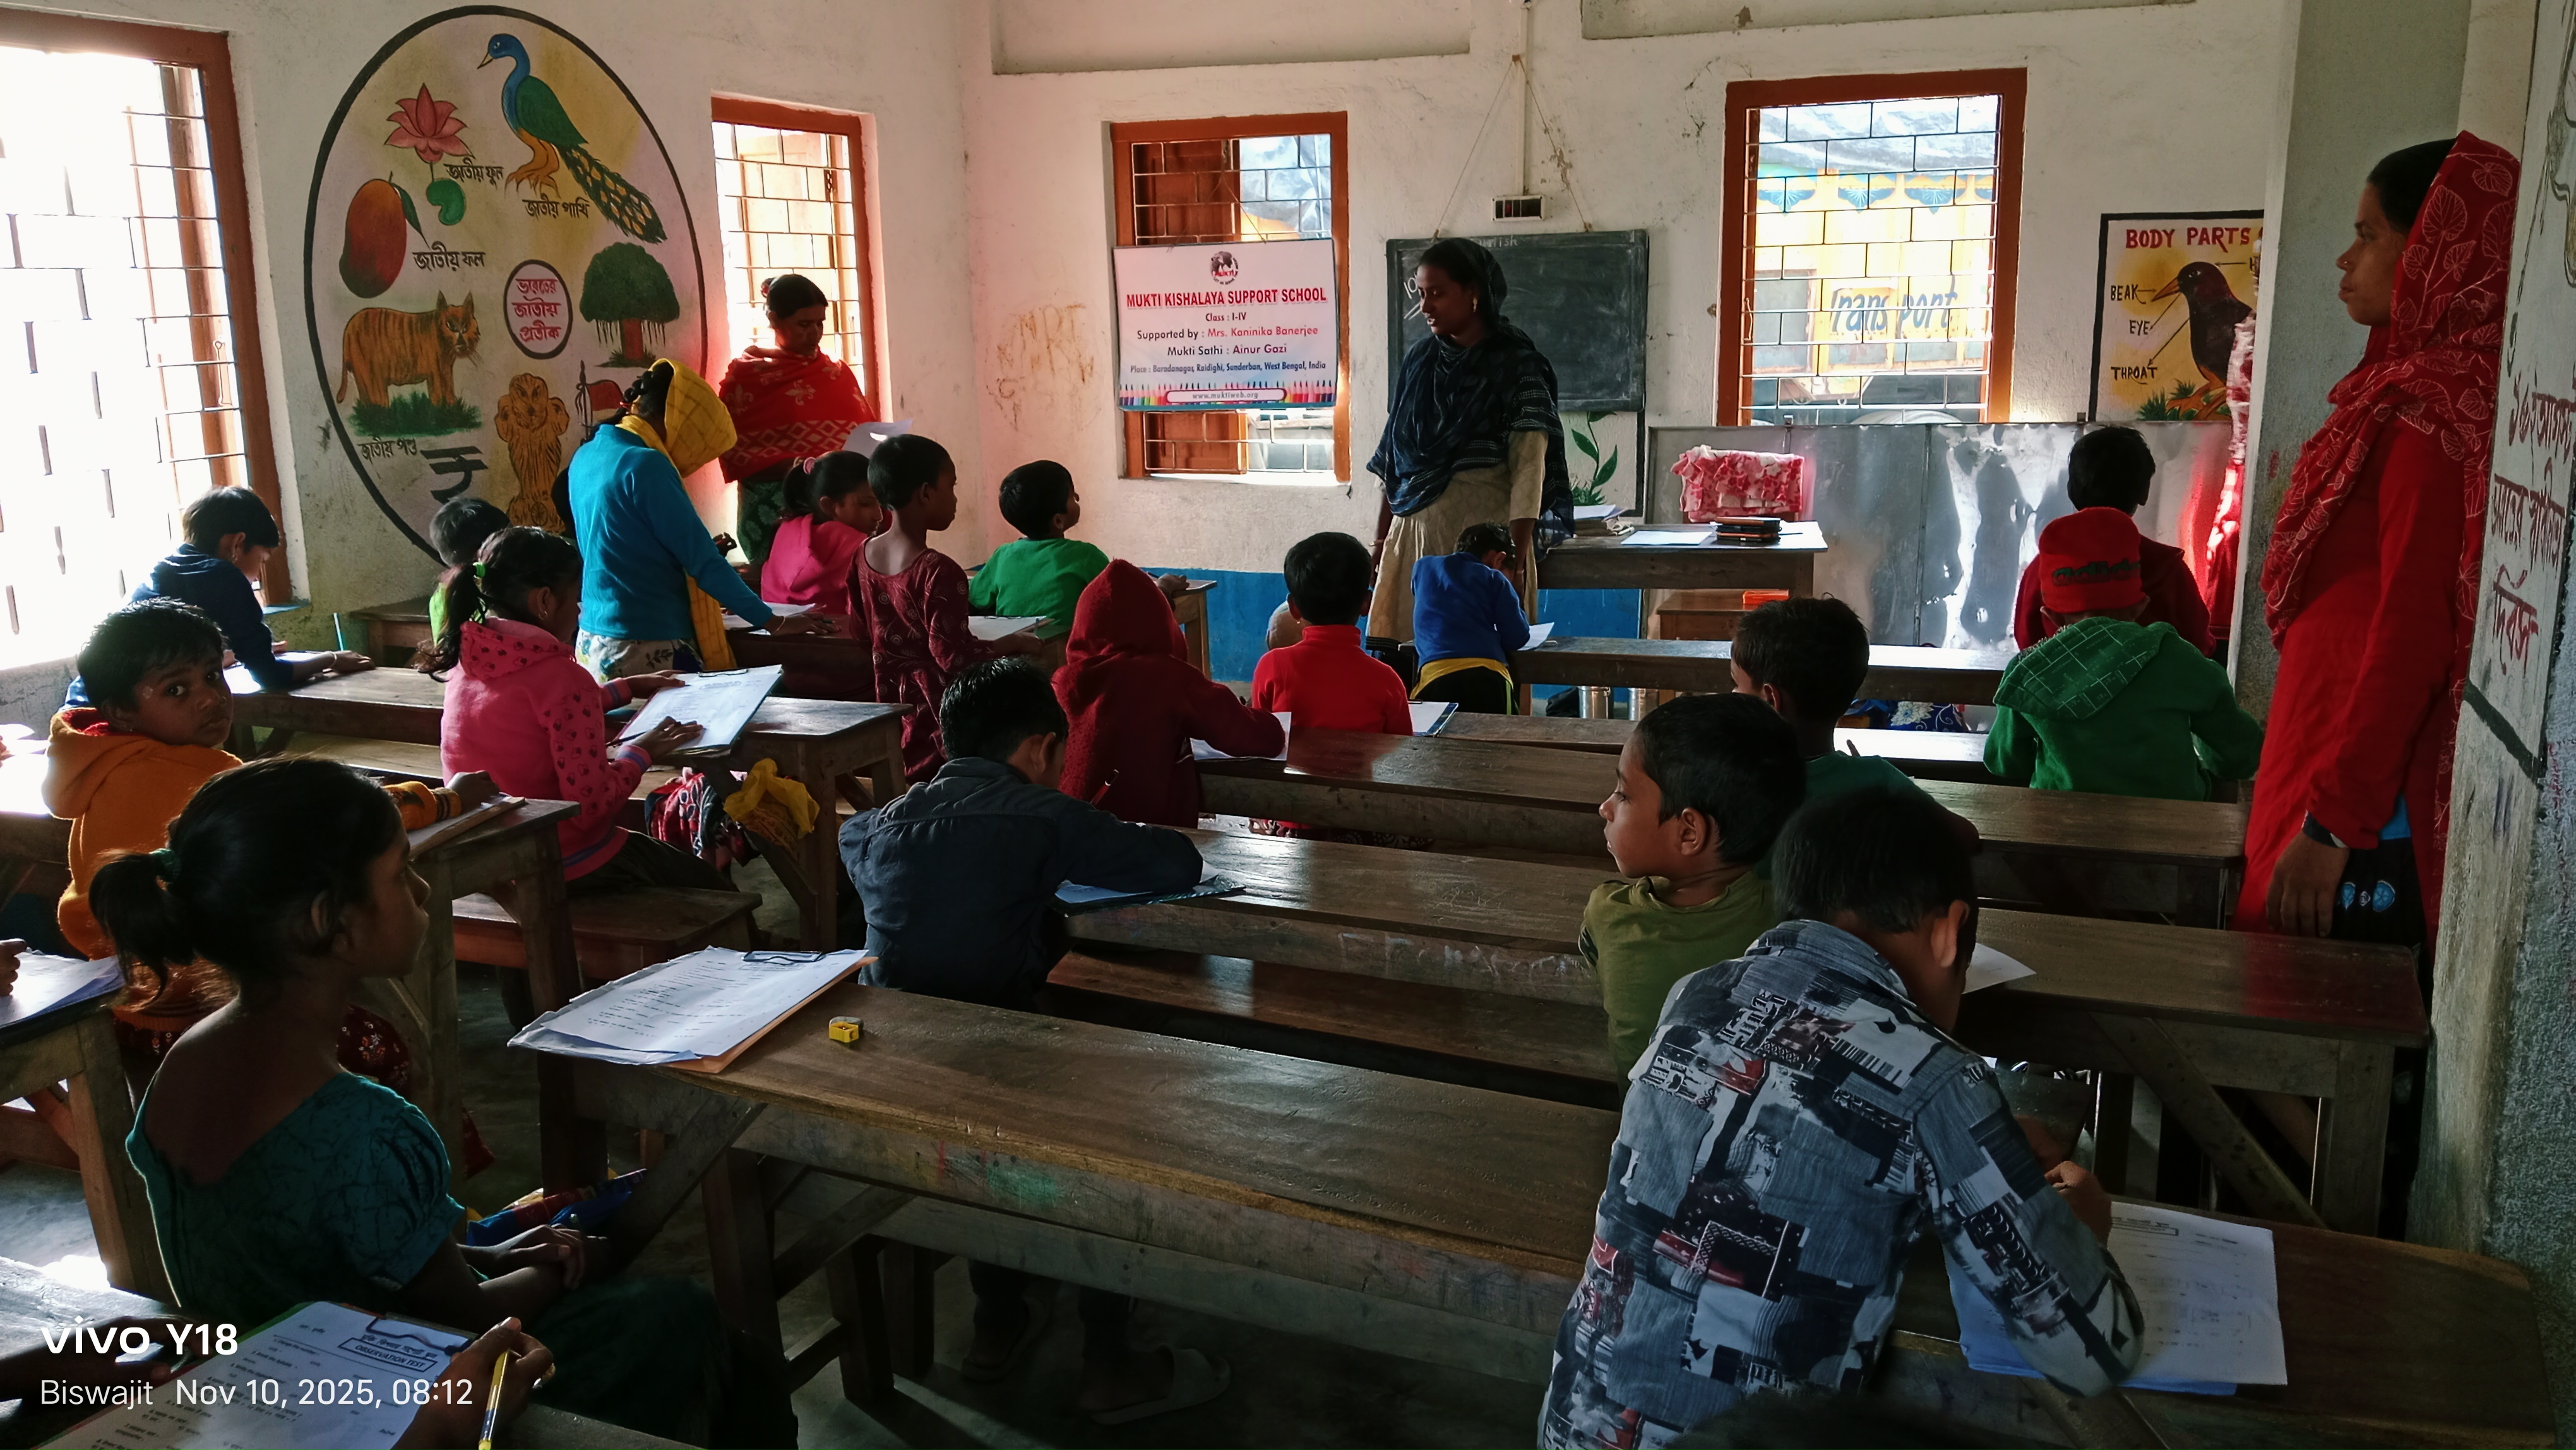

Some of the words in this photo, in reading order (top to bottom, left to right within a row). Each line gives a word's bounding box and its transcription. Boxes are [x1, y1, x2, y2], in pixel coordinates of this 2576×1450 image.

[443, 157, 484, 183] জাতীয়
[522, 193, 561, 219] জাতীয়
[561, 196, 590, 219] পাখি
[2125, 229, 2176, 249] BODY
[2186, 227, 2251, 253] PARTS
[412, 241, 460, 272] জাতীয়
[461, 251, 486, 267] ফল
[1127, 294, 1161, 308] MUKTI
[1165, 291, 1225, 306] KISHALAYA
[1228, 289, 1278, 304] SUPPORT
[1282, 287, 1327, 303] SCHOOL
[2111, 284, 2147, 304] BEAK
[1232, 312, 1247, 321] I-IV
[1137, 328, 1184, 341] Supported
[1188, 328, 1199, 340] by
[1208, 328, 1227, 337] Mrs.
[1231, 327, 1272, 337] Kaninika
[1276, 325, 1318, 337] Banerjee
[2130, 320, 2150, 335] EYE
[1167, 346, 1195, 356] Mukti
[1198, 345, 1223, 355] Sathi
[1232, 344, 1261, 354] Ainur
[1264, 343, 1287, 353] Gazi
[1130, 365, 1147, 373] Place
[1227, 362, 1263, 371] Sunderban,
[1282, 361, 1307, 371] Bengal,
[1309, 361, 1326, 369] India
[2111, 366, 2157, 385] THROAT
[1192, 390, 1258, 399] www.muktiweb.org
[354, 1345, 407, 1363] OBSERVATION
[405, 1359, 426, 1368] TEST
